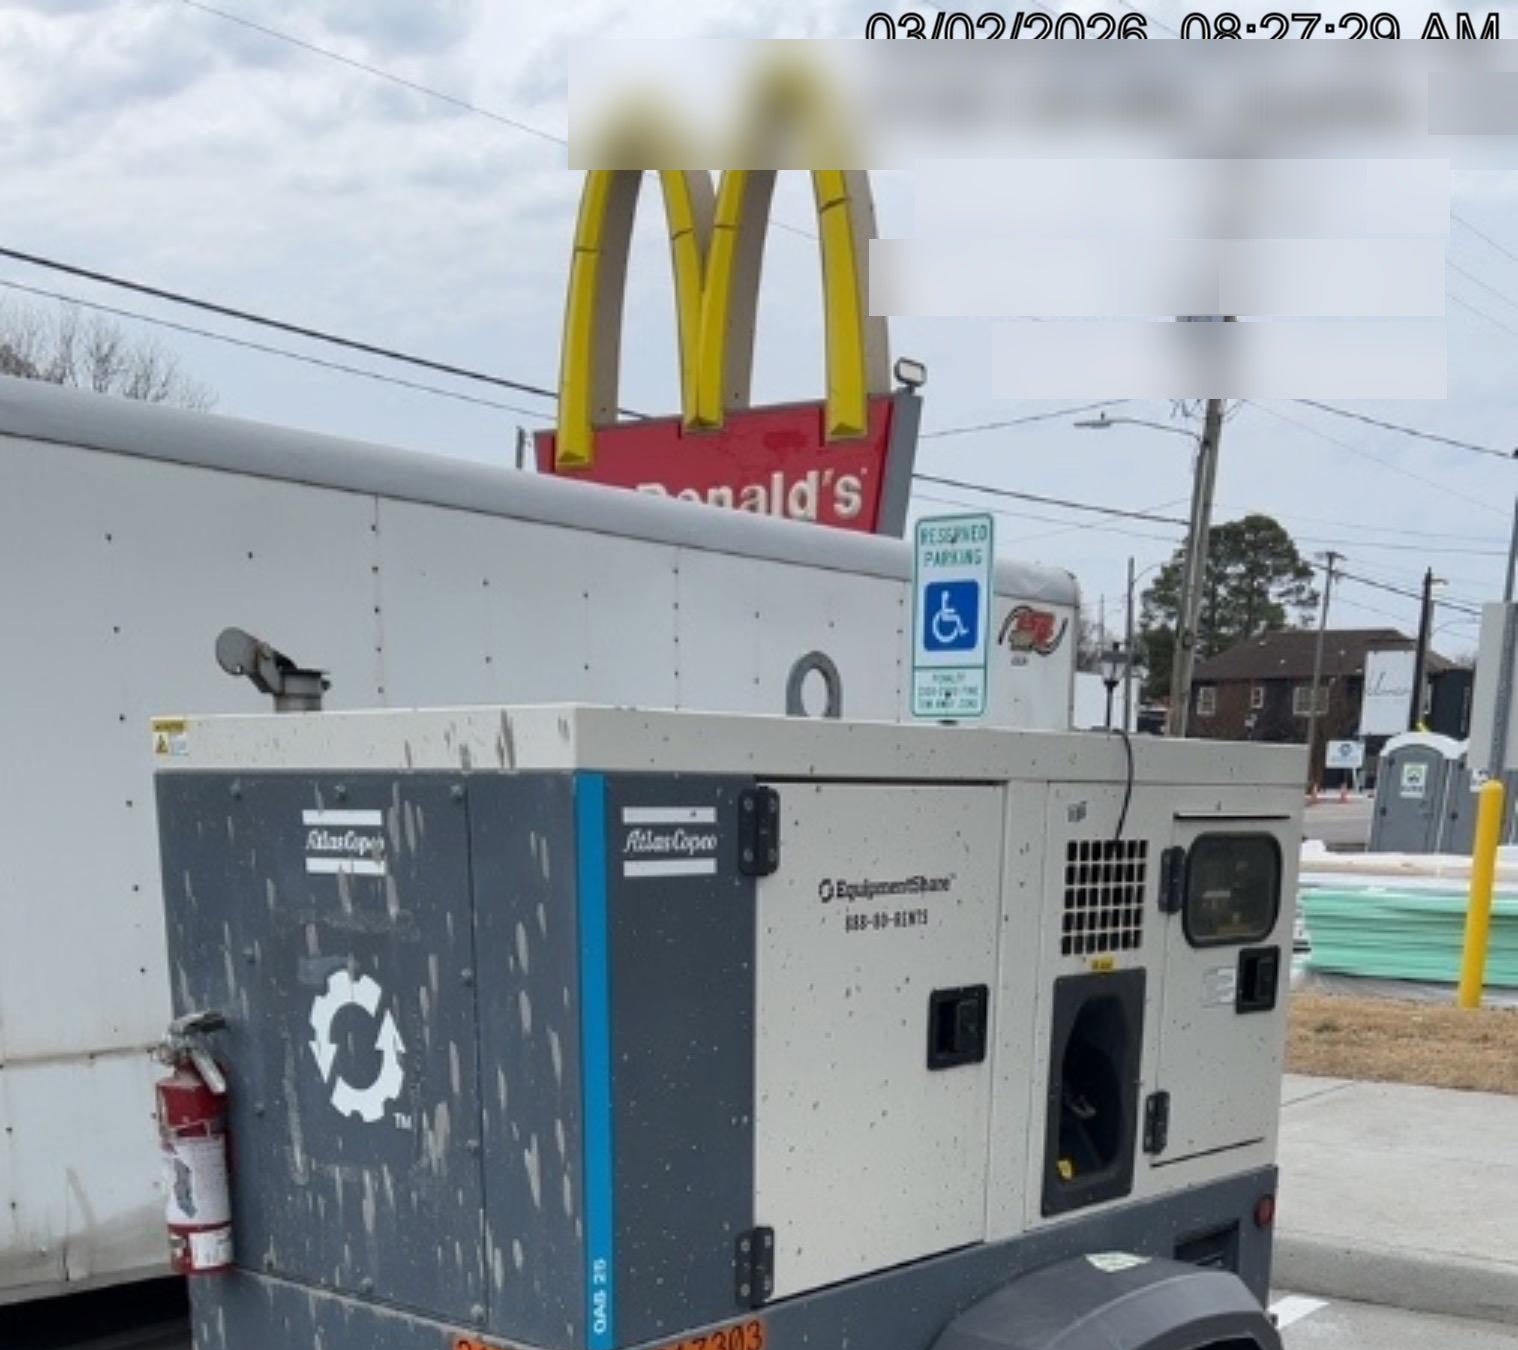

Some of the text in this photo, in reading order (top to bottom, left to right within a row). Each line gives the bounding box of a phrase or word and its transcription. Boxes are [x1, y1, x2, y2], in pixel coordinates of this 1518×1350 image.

[636, 467, 863, 521] nald's
[920, 524, 987, 546] RESERVED
[924, 548, 982, 568] PARKING
